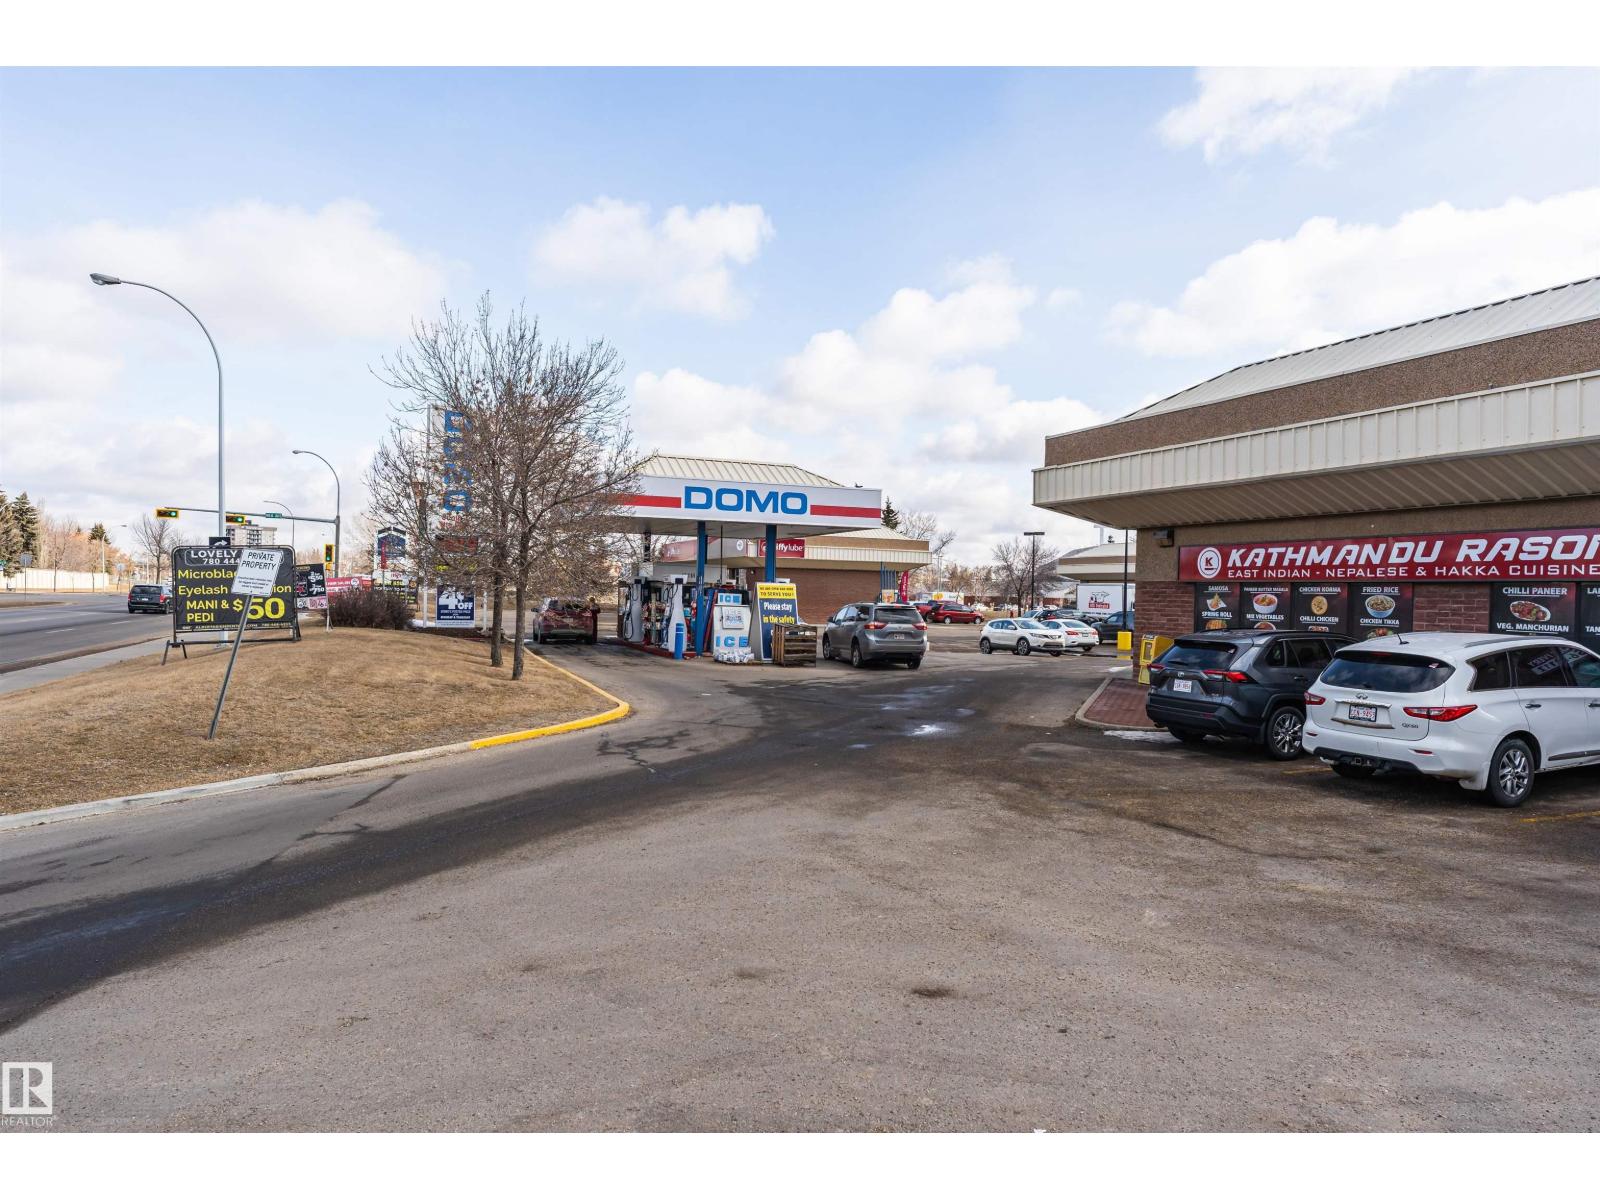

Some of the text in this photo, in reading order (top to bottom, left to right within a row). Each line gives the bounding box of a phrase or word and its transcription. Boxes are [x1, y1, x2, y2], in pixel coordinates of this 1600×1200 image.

[685, 486, 808, 515] DOMO
[191, 550, 237, 558] LOVELY
[247, 551, 274, 561] PRIVATE
[1227, 540, 1444, 567] KATHMANDU
[241, 560, 277, 570] PROPERTY
[1204, 557, 1213, 567] K
[1228, 569, 1259, 578] EAST
[1263, 568, 1311, 578] INDIAN
[1325, 567, 1409, 577] NEPALESE
[1415, 566, 1427, 576] &
[1434, 565, 1500, 576] HAKKA
[1509, 564, 1600, 576] CUISINE
[178, 584, 228, 597] Eyelash
[1531, 587, 1568, 595] PANEER
[186, 599, 229, 610] MANI &
[457, 602, 474, 610] OFF
[763, 601, 793, 613] Please stay
[186, 612, 214, 622] PEDI
[763, 614, 795, 625] in the safety
[1515, 623, 1569, 633] MANCHURIAN
[715, 636, 750, 648] ICE
